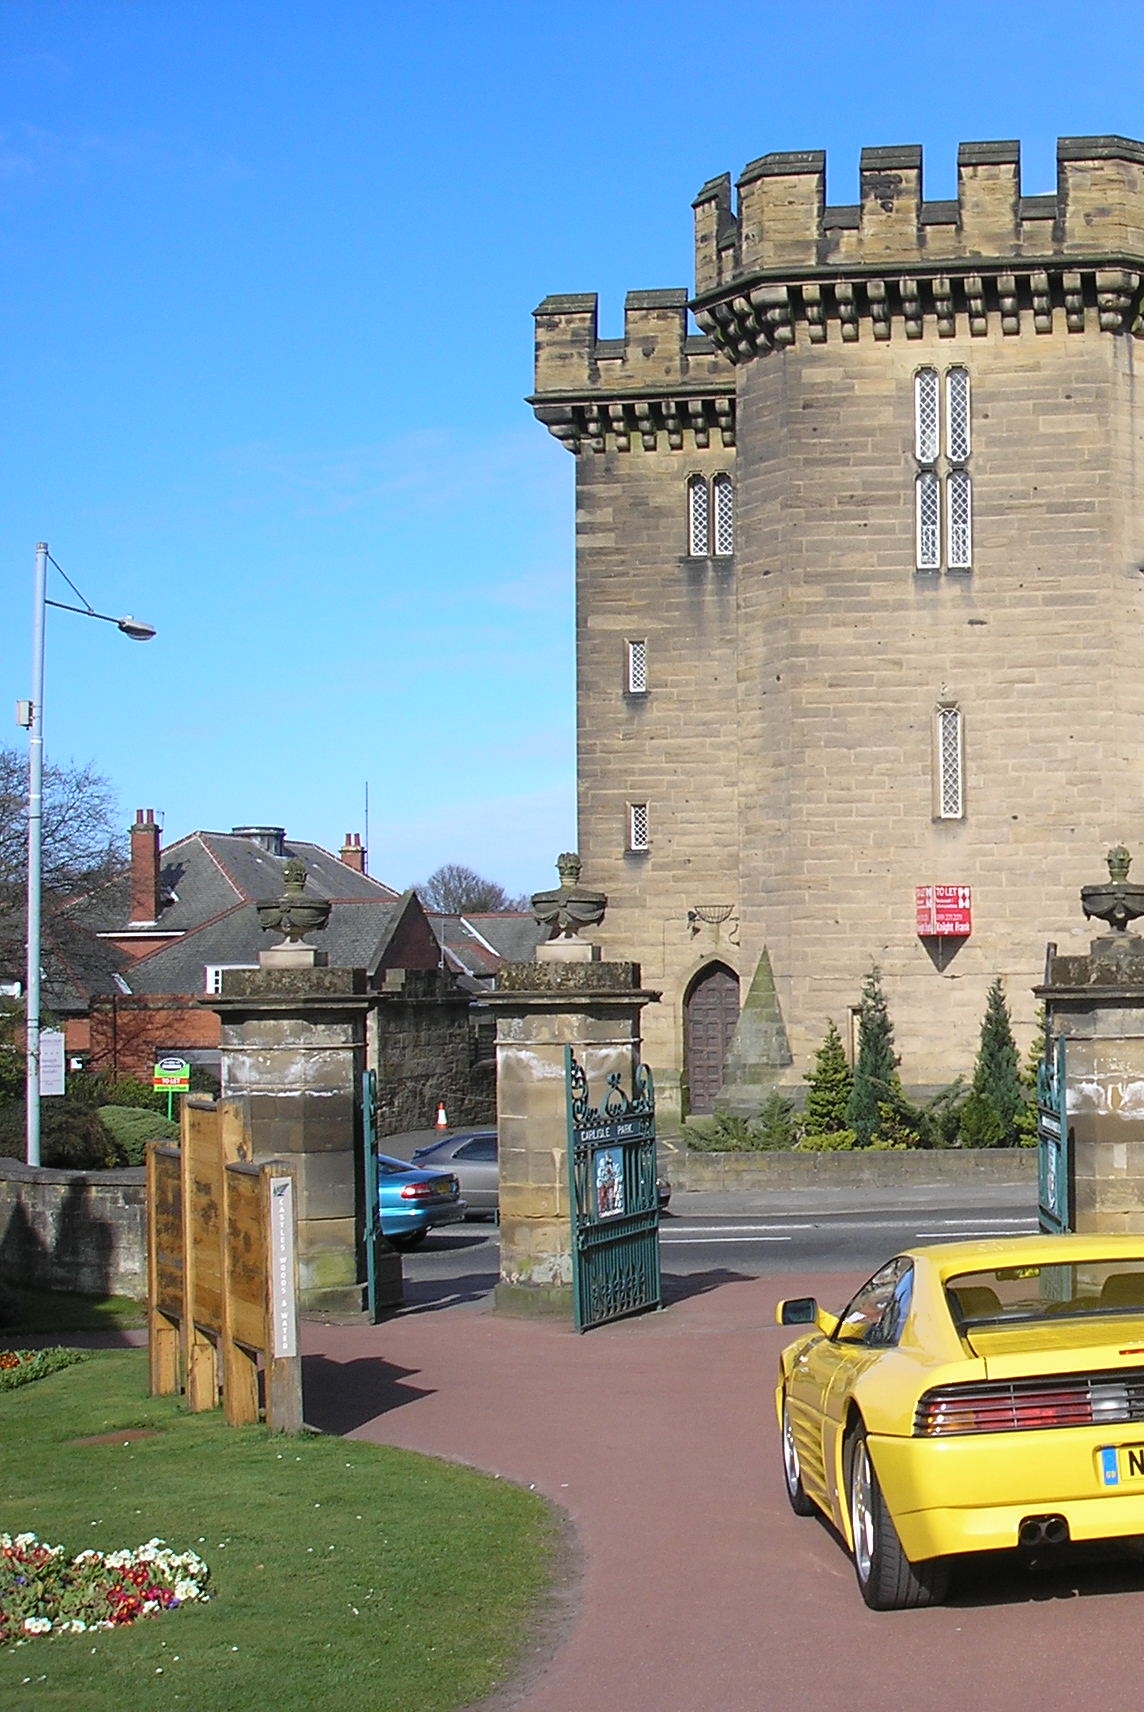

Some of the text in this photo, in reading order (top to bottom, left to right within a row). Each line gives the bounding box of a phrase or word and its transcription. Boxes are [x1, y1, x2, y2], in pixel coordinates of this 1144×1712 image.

[936, 887, 945, 896] TO
[945, 887, 957, 896] LET
[936, 921, 954, 934] Knight
[955, 921, 970, 931] Frank
[581, 1123, 634, 1141] CARLISLE PARK
[279, 1256, 287, 1295] WOODS
